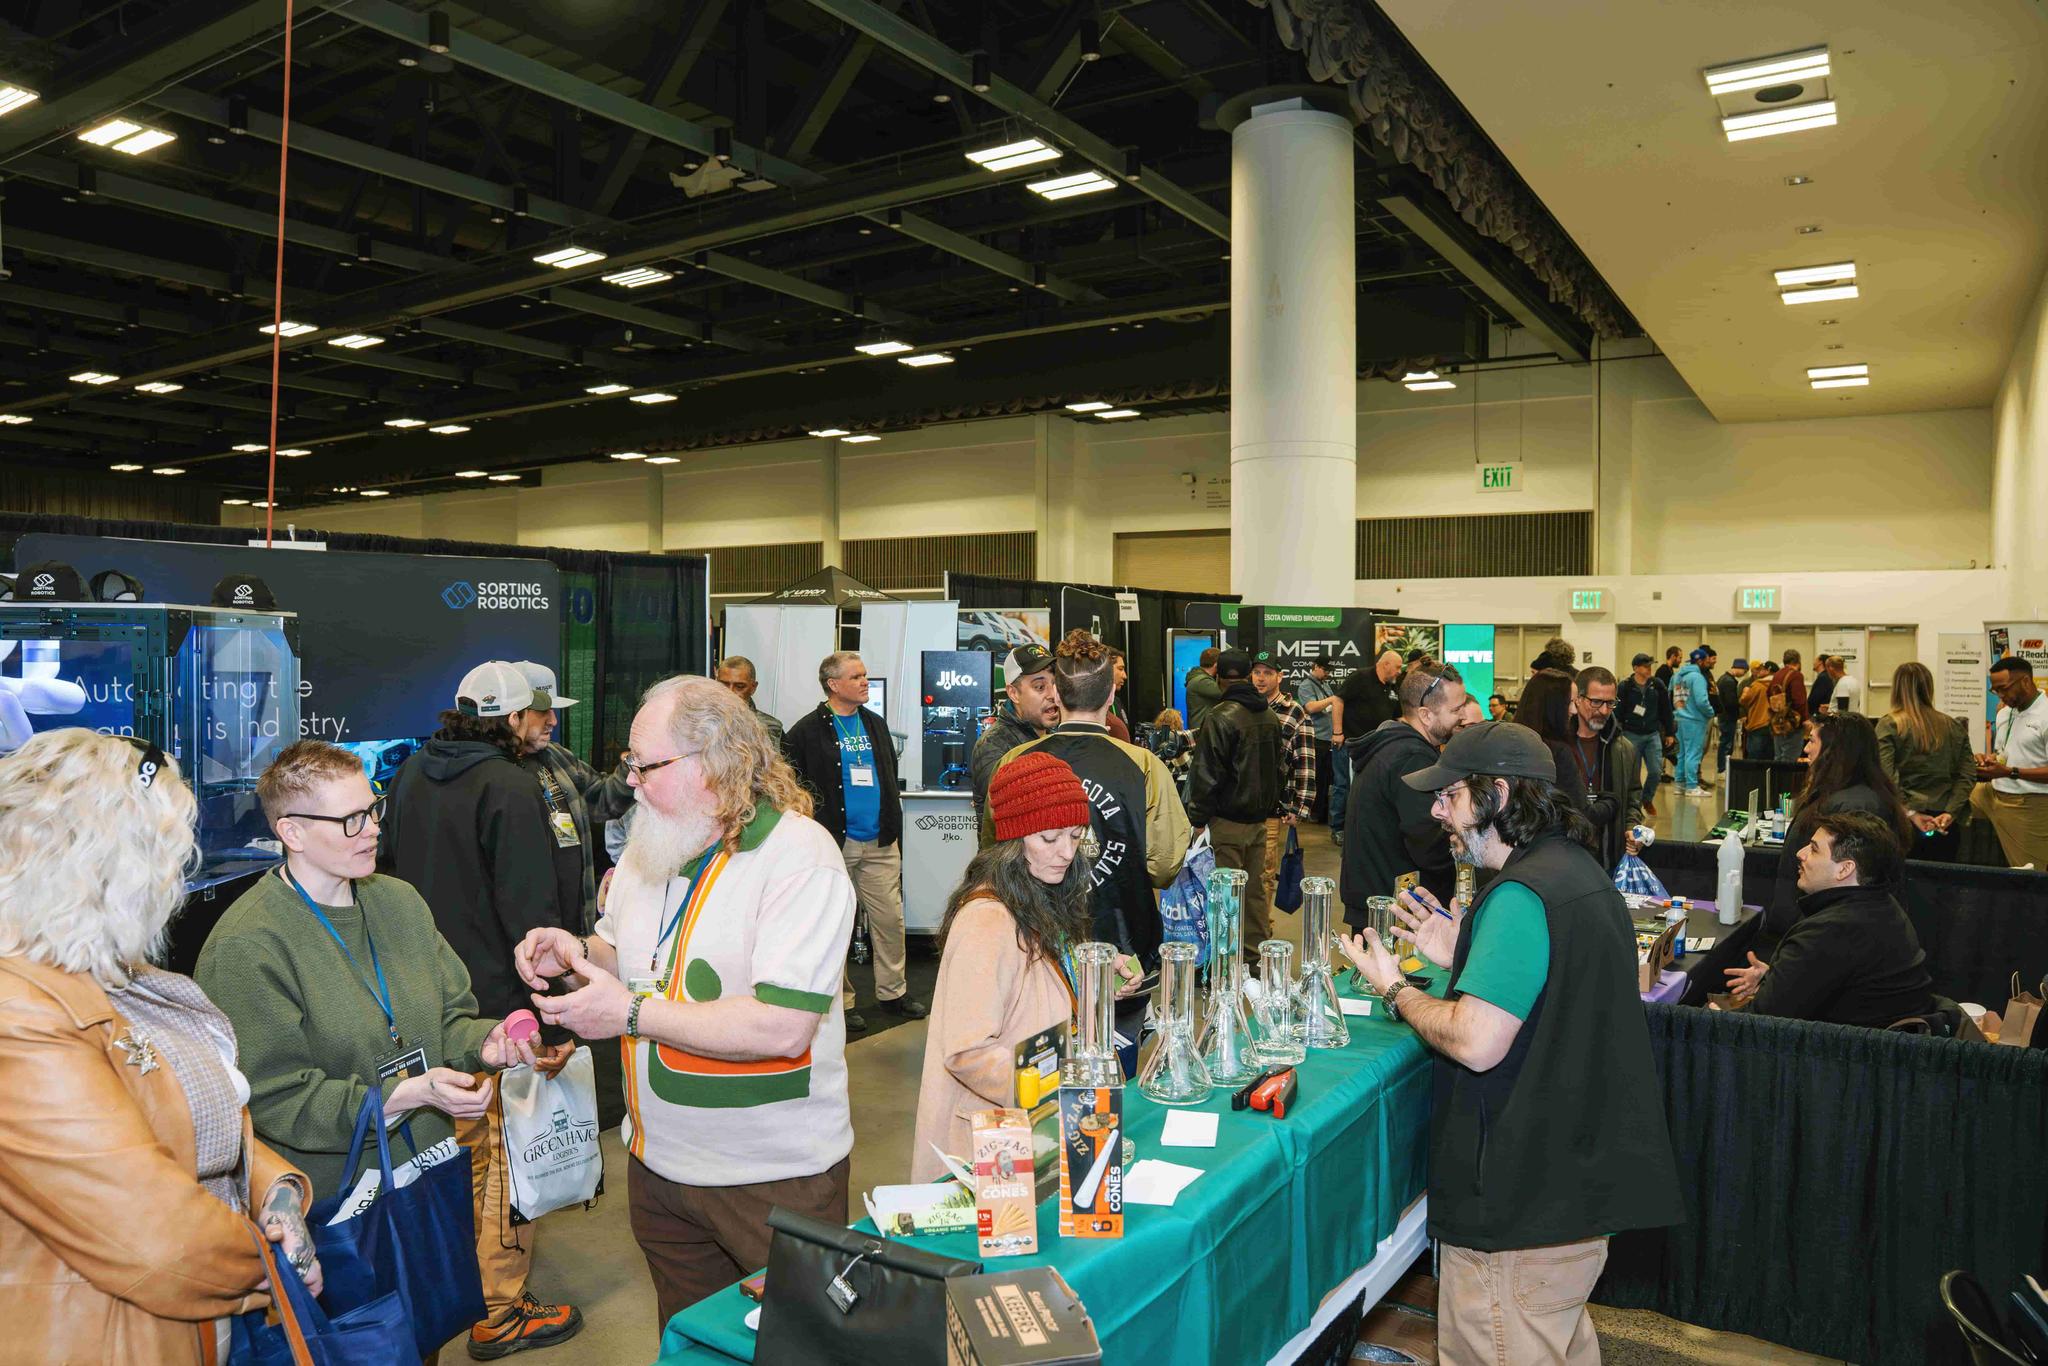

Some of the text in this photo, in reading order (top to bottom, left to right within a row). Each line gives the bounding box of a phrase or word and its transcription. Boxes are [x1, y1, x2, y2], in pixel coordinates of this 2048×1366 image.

[1483, 467, 1512, 487] EXIT
[478, 582, 542, 595] SORTING
[477, 597, 550, 610] ROBOTICS
[1572, 592, 1601, 610] EXIT
[1743, 589, 1776, 609] EXIT
[1277, 640, 1361, 657] META
[1444, 650, 1493, 663] WE'VE
[269, 671, 313, 699] te
[240, 708, 351, 742] indstry.
[938, 815, 978, 823] SORTING
[524, 1136, 565, 1164] GREEN
[553, 1147, 579, 1161] LOGISTICS
[977, 1140, 1029, 1158] ZIG-ZAG
[981, 1185, 1029, 1199] CONES
[1110, 1165, 1122, 1212] CONES
[1003, 1296, 1038, 1334] KEEPERS
